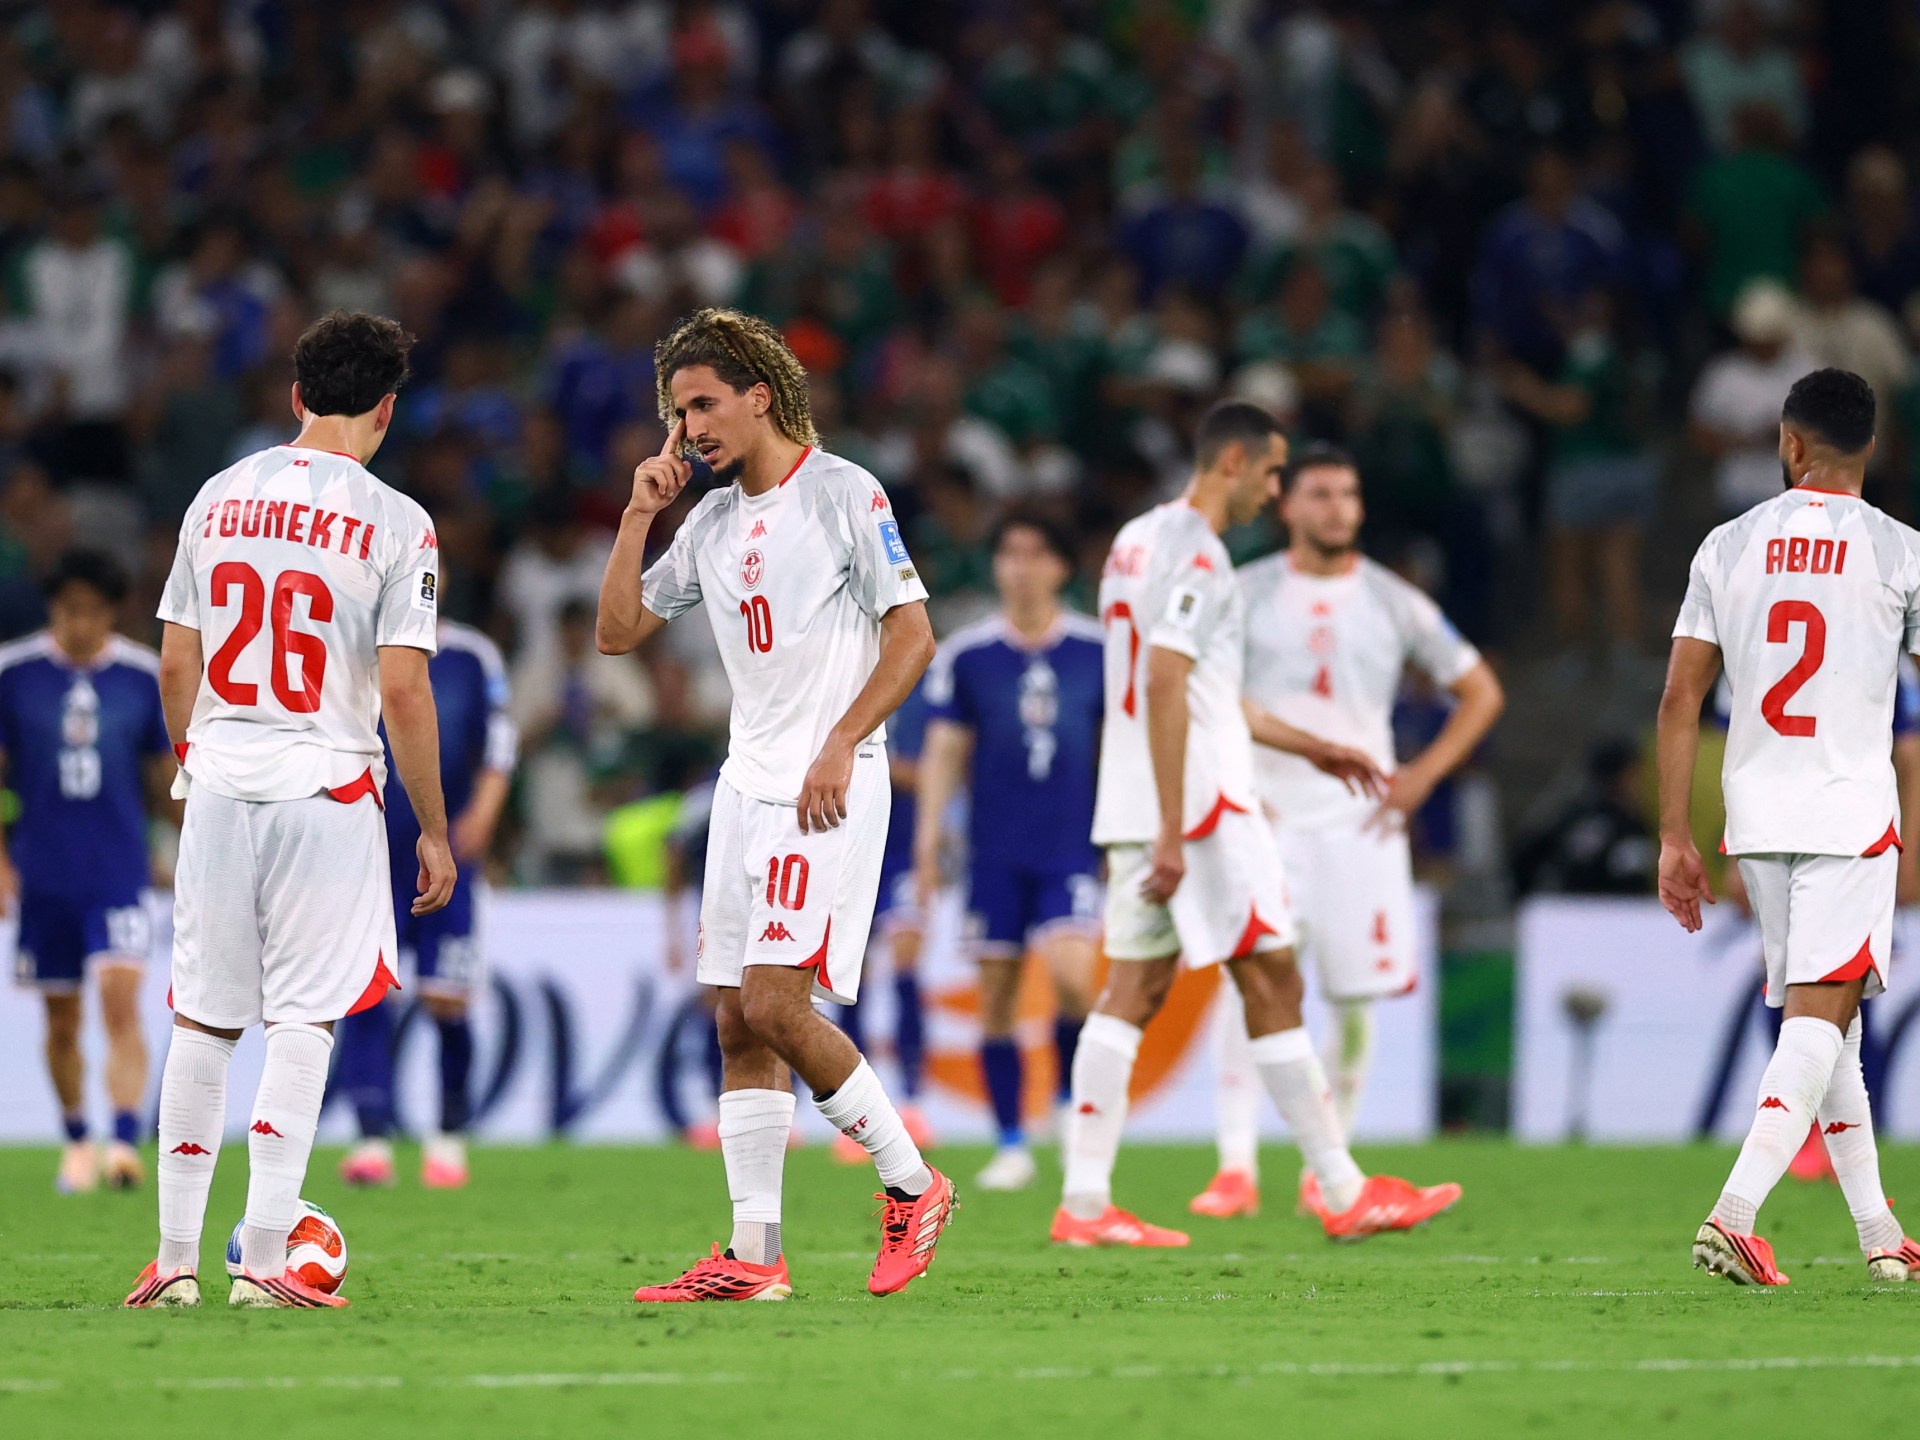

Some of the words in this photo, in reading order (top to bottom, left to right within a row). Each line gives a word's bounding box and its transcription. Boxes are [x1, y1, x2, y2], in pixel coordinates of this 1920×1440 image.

[1766, 537, 1848, 575] ABDI
[208, 561, 334, 713] 26
[740, 594, 773, 654] 10
[1761, 600, 1826, 737] 2
[766, 853, 809, 911] 10
